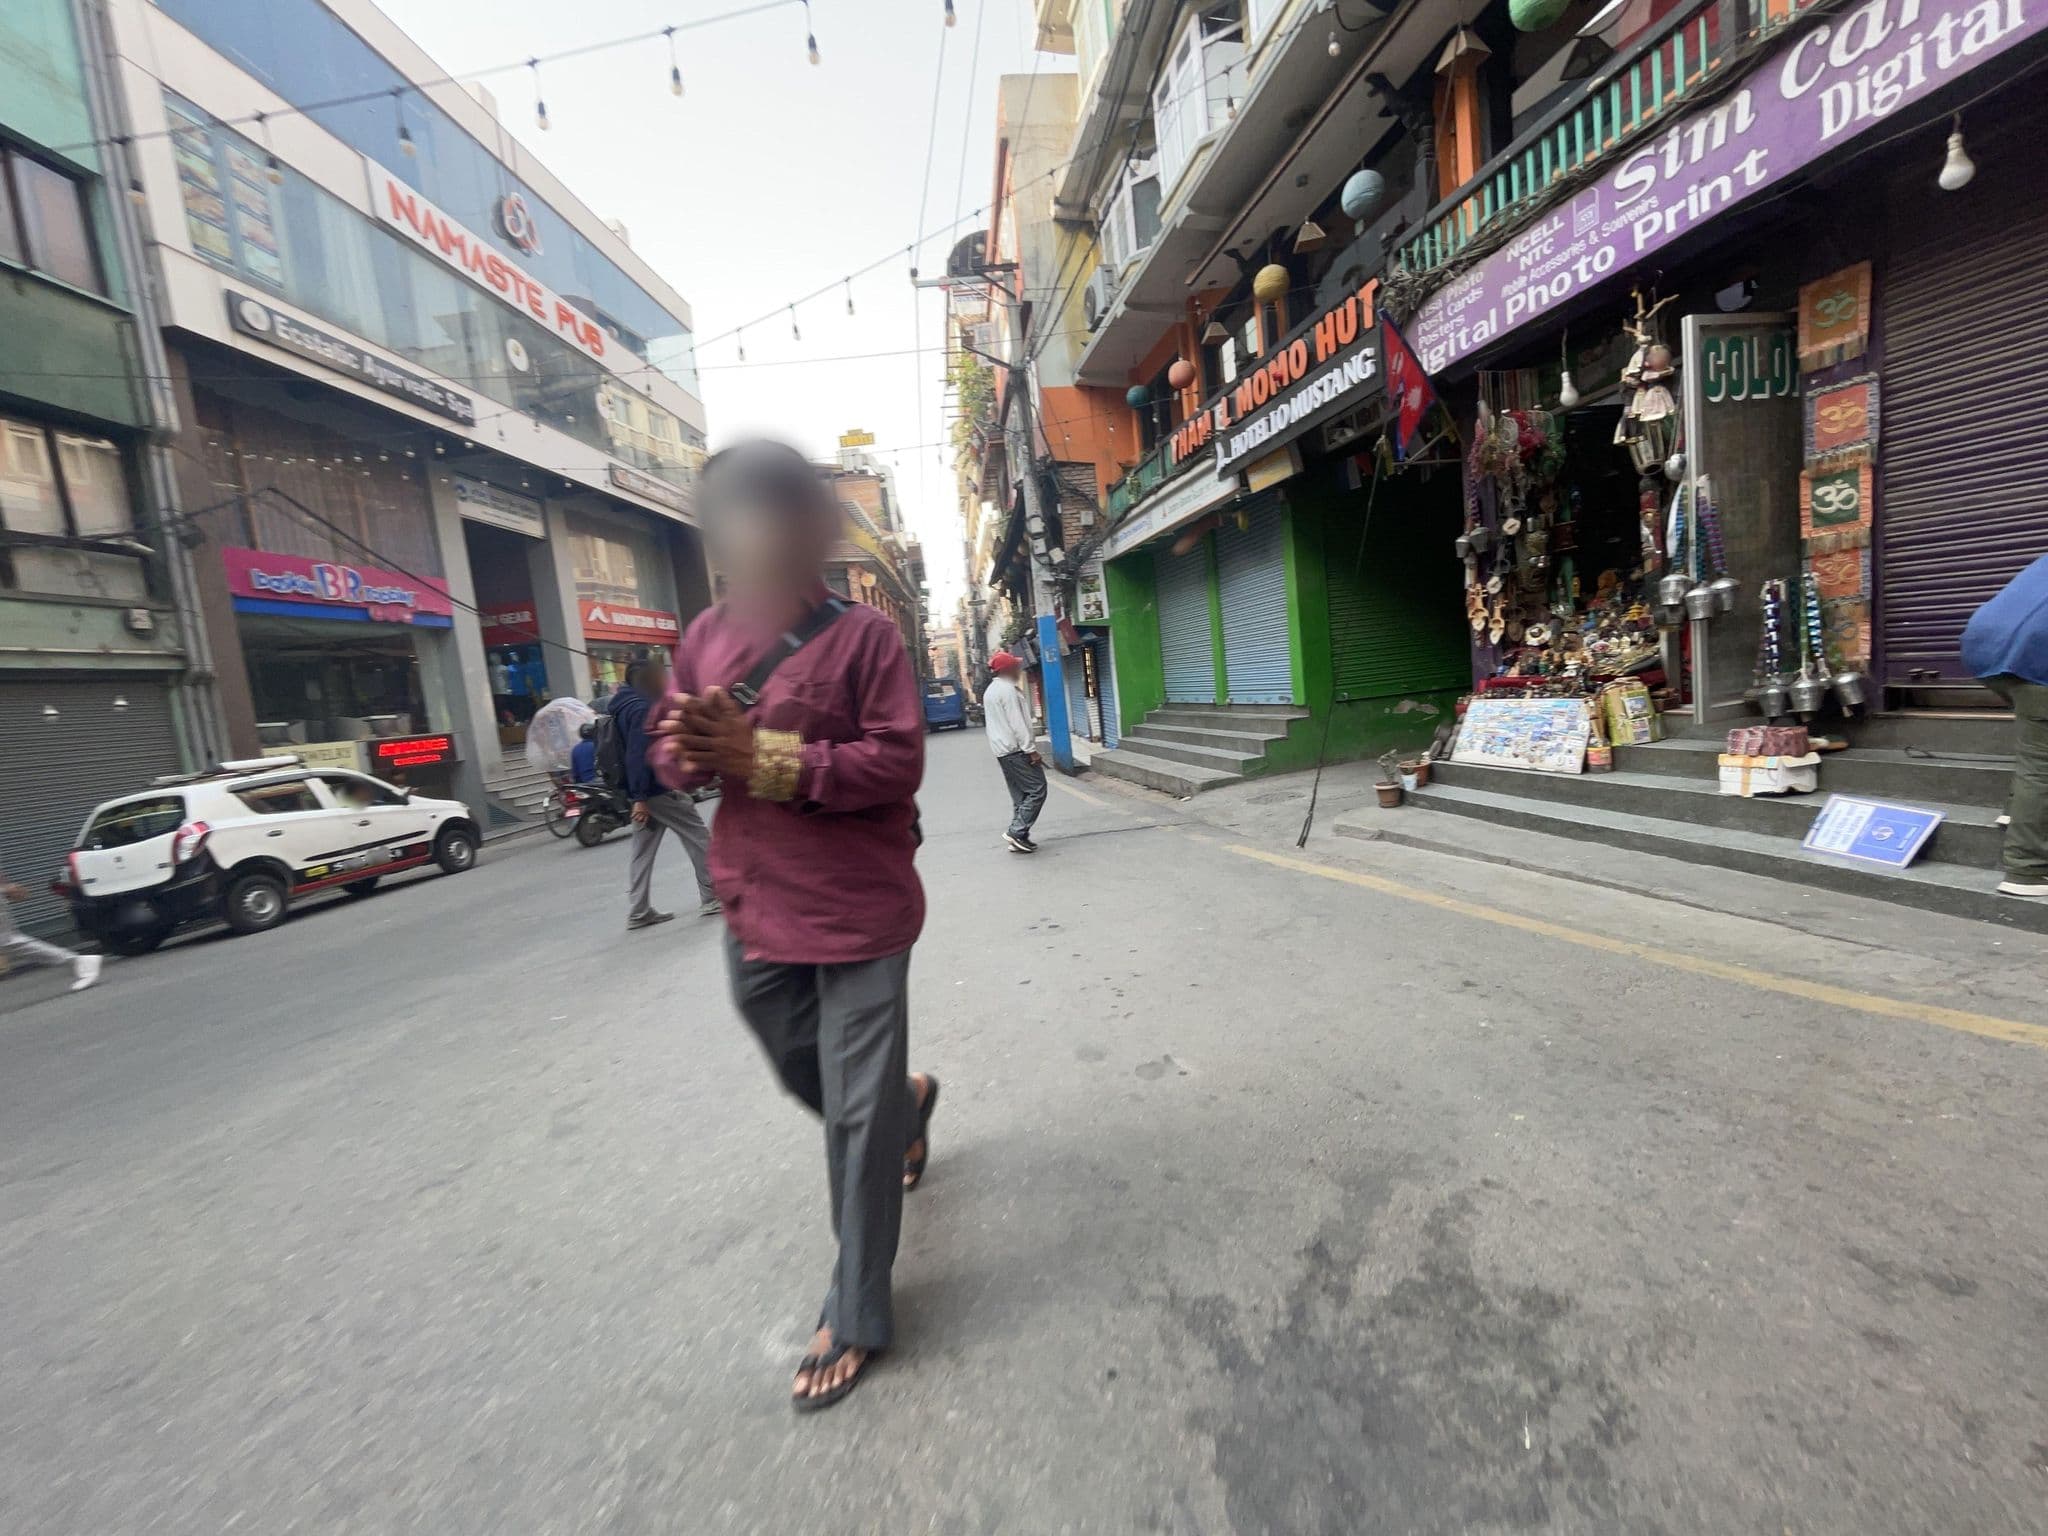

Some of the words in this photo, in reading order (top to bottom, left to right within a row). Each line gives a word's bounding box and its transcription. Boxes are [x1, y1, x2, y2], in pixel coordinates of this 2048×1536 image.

[1613, 87, 1757, 212] Sim
[1506, 215, 1565, 263] NCELL
[1588, 230, 1600, 245] &
[1601, 196, 1660, 237] Souvenirs
[386, 180, 547, 320] NAMASTE
[555, 302, 604, 357] PUB
[1416, 308, 1497, 375] igital
[1505, 245, 1616, 325] Photo
[1633, 146, 1769, 252] Print
[1519, 238, 1555, 271] NTC
[1418, 310, 1443, 336] Post
[1447, 287, 1484, 316] Cards
[1418, 314, 1465, 350] Posters
[1235, 338, 1308, 419] MOMO
[1315, 277, 1379, 363] HUT
[1290, 347, 1377, 424] MUSTANG
